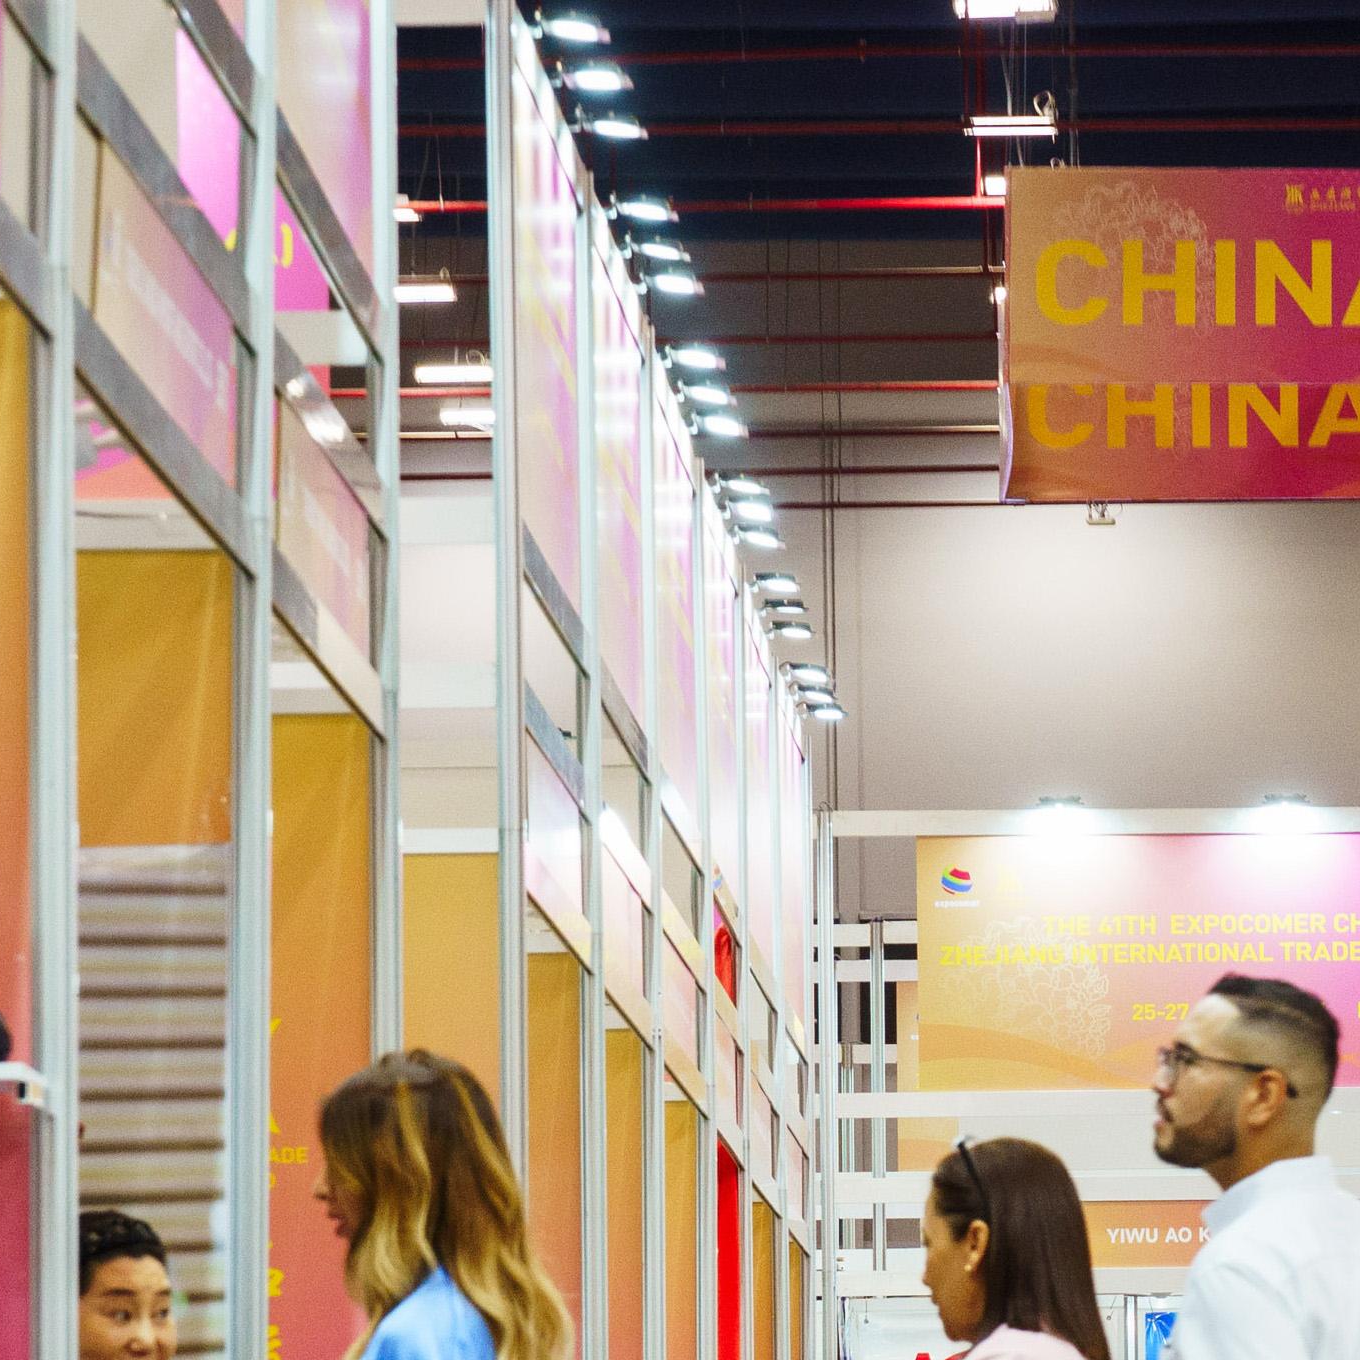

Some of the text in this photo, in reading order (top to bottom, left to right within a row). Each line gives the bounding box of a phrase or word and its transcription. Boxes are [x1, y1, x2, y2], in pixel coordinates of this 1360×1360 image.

[1043, 914, 1090, 936] THE
[1098, 914, 1156, 935] 41TH
[1170, 913, 1326, 934] EXPOCOMER
[939, 944, 1065, 966] ZHEJIANG
[1072, 942, 1273, 965] INTERNATIONAL
[1132, 1003, 1190, 1021] 25-27
[1106, 1228, 1158, 1243] YIWU
[1165, 1227, 1193, 1243] AO
